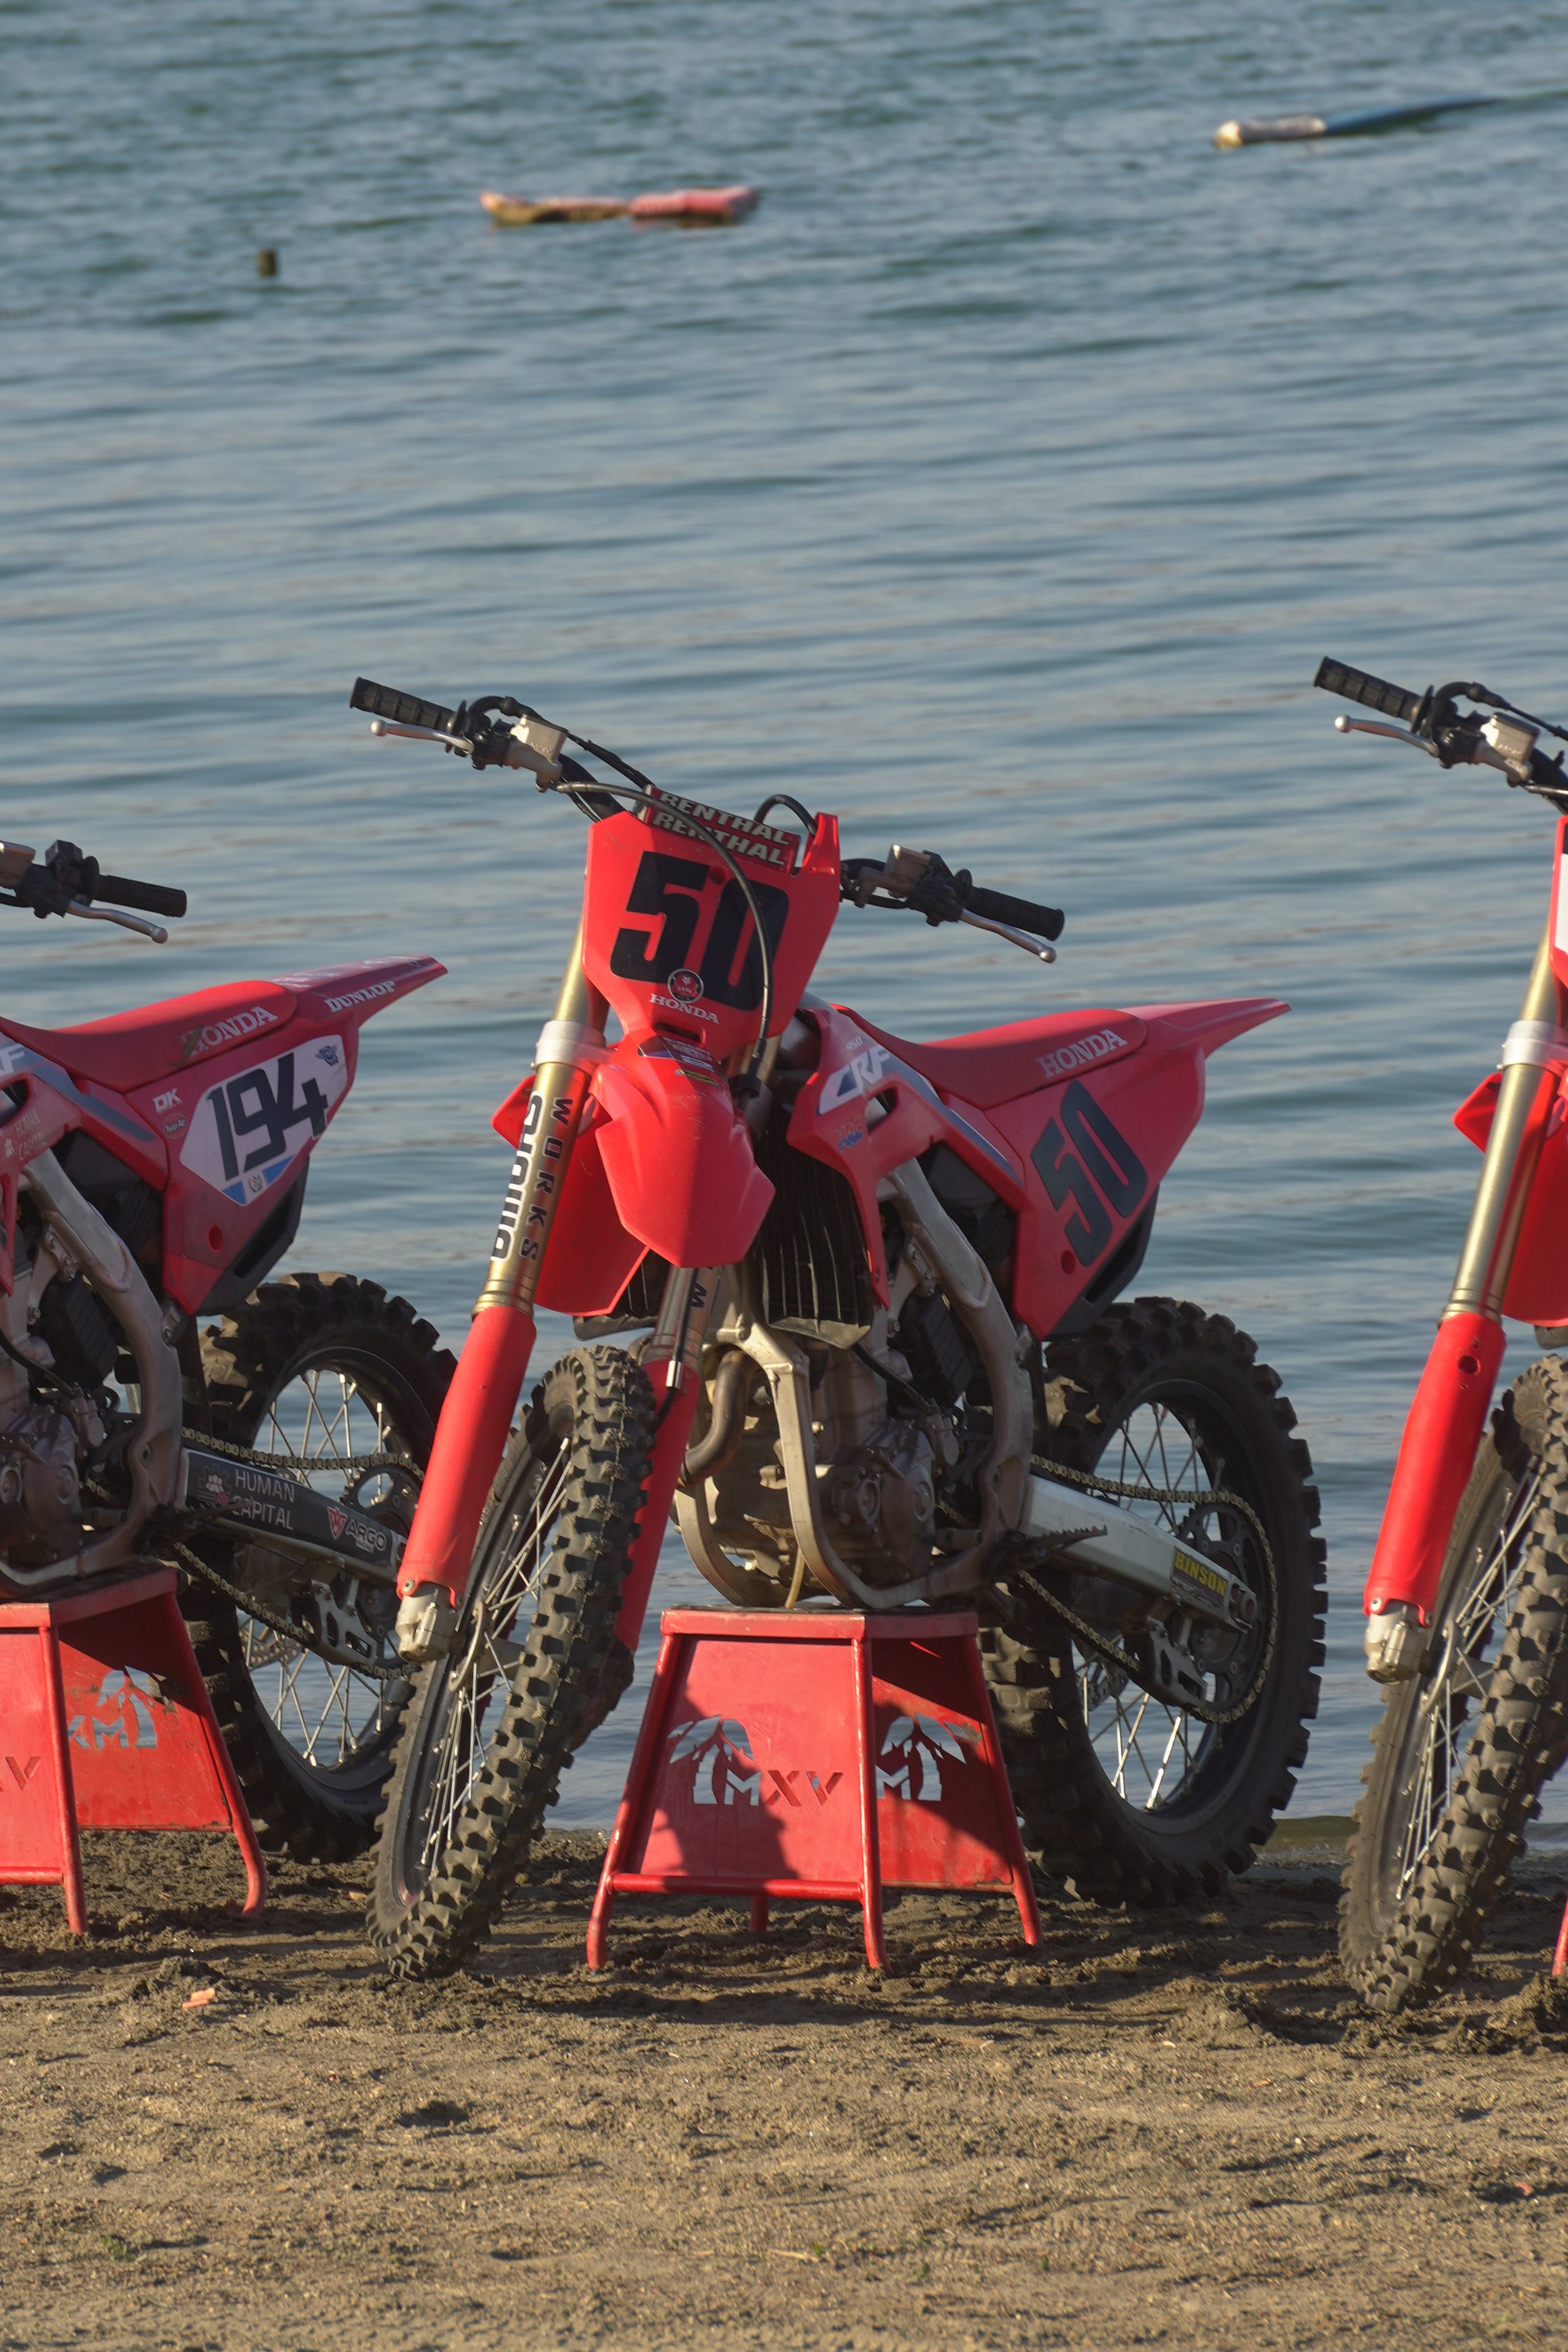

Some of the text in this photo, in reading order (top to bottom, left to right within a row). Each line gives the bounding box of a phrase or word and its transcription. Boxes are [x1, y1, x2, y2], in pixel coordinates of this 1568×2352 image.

[659, 792, 790, 845] RENTHAL
[610, 850, 790, 1012] 50
[324, 980, 396, 1013] DUNLOP
[649, 993, 720, 1024] HONDA
[1036, 1029, 1129, 1078] HONDA
[152, 1087, 183, 1113] DK
[819, 1044, 891, 1115] CRF
[206, 1052, 329, 1181] 194
[519, 1097, 573, 1261] WORKS
[1030, 1080, 1148, 1267] 50
[235, 1469, 295, 1503] HUMAN
[232, 1495, 294, 1530] CAPITAL
[344, 1518, 387, 1552] ARGO
